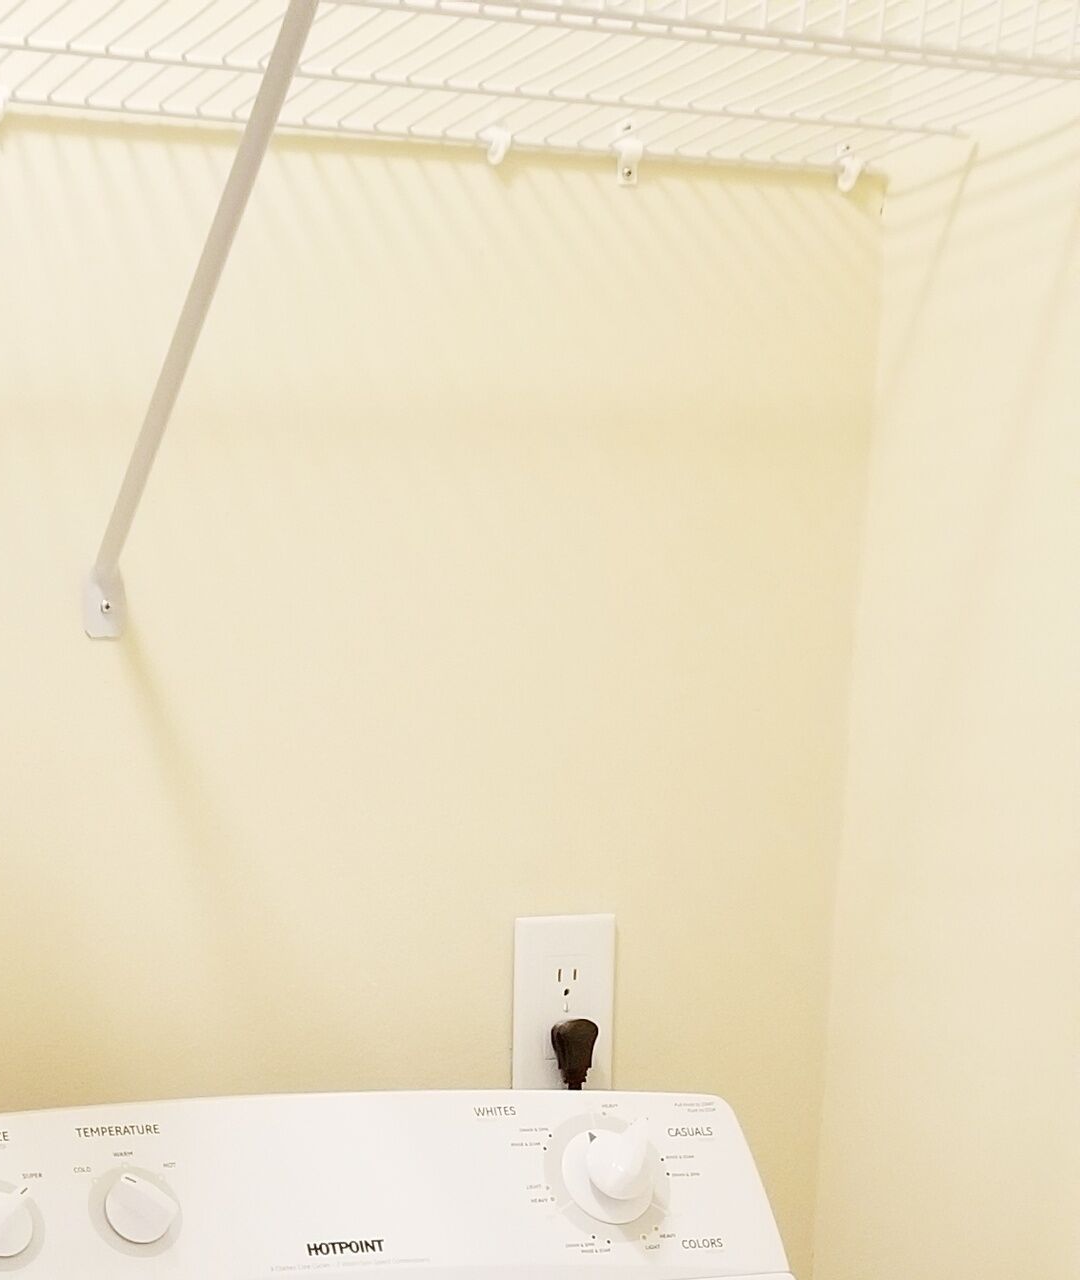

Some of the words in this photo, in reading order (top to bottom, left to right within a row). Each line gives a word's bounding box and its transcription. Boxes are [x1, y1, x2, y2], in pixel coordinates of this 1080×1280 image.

[473, 1106, 517, 1117] WHITES
[75, 1124, 161, 1138] TEMPERATURE
[667, 1126, 713, 1137] CASUALS
[73, 1166, 92, 1174] COLD
[21, 1172, 43, 1180] SUPER
[306, 1239, 385, 1256] HOTPOINT
[681, 1238, 724, 1249] COLORS
